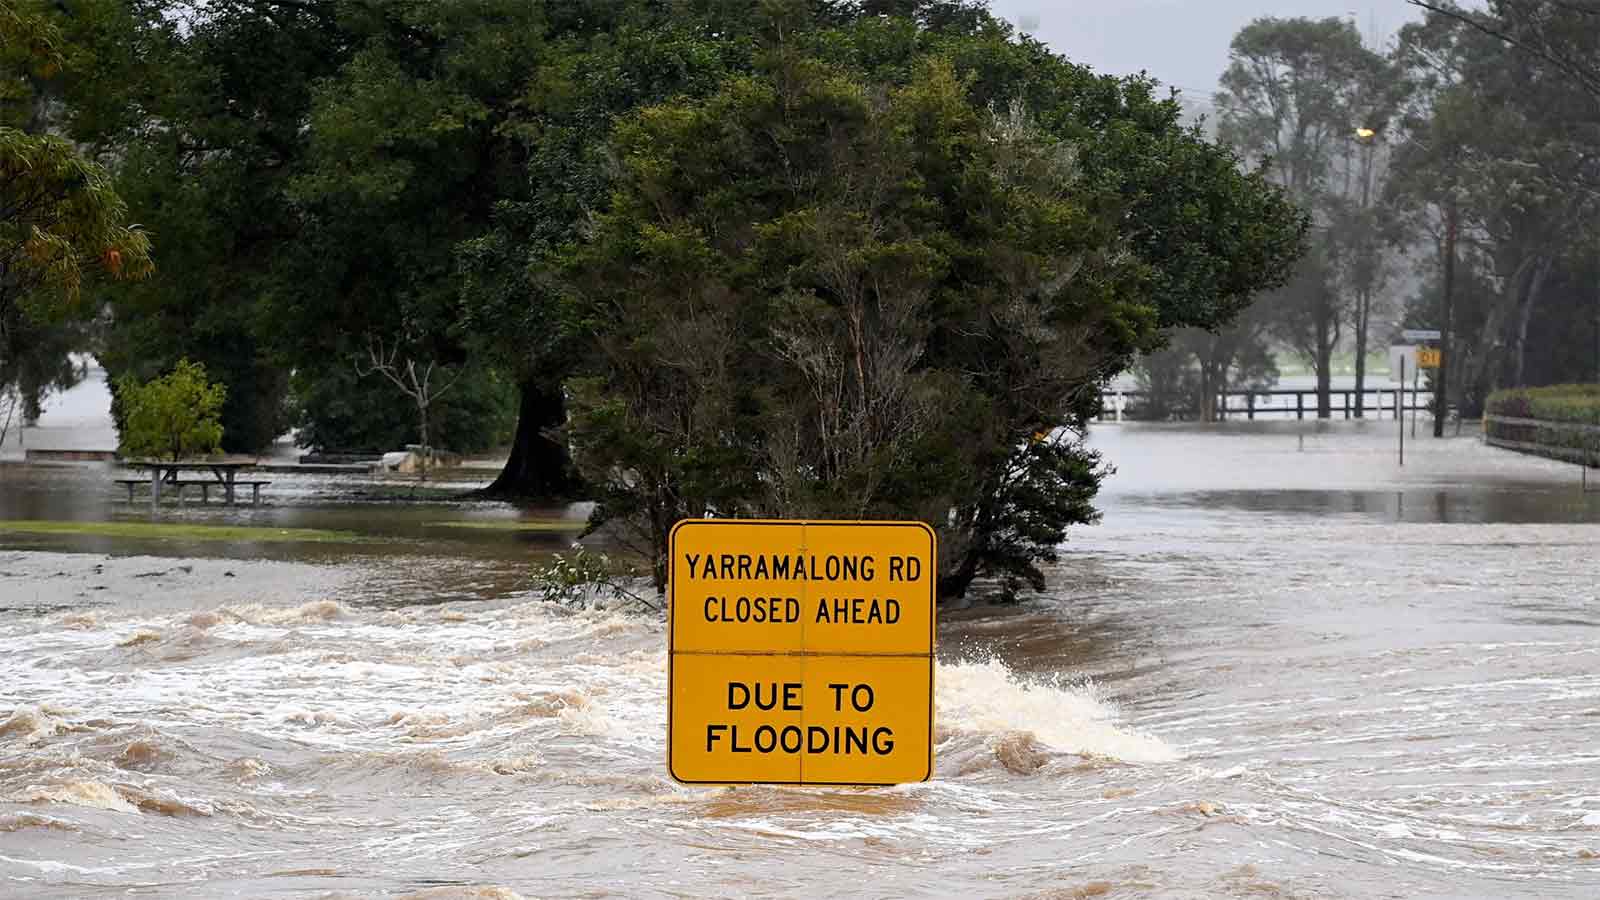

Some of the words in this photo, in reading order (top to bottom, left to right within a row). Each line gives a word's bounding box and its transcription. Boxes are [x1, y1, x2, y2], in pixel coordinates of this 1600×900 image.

[685, 554, 874, 581] YARRAMALONG
[890, 556, 921, 582] RD
[704, 597, 800, 623] CLOSED
[816, 599, 900, 624] AHEAD
[728, 683, 802, 711] DUE
[829, 684, 875, 712] TO
[707, 725, 894, 755] FLOODING
